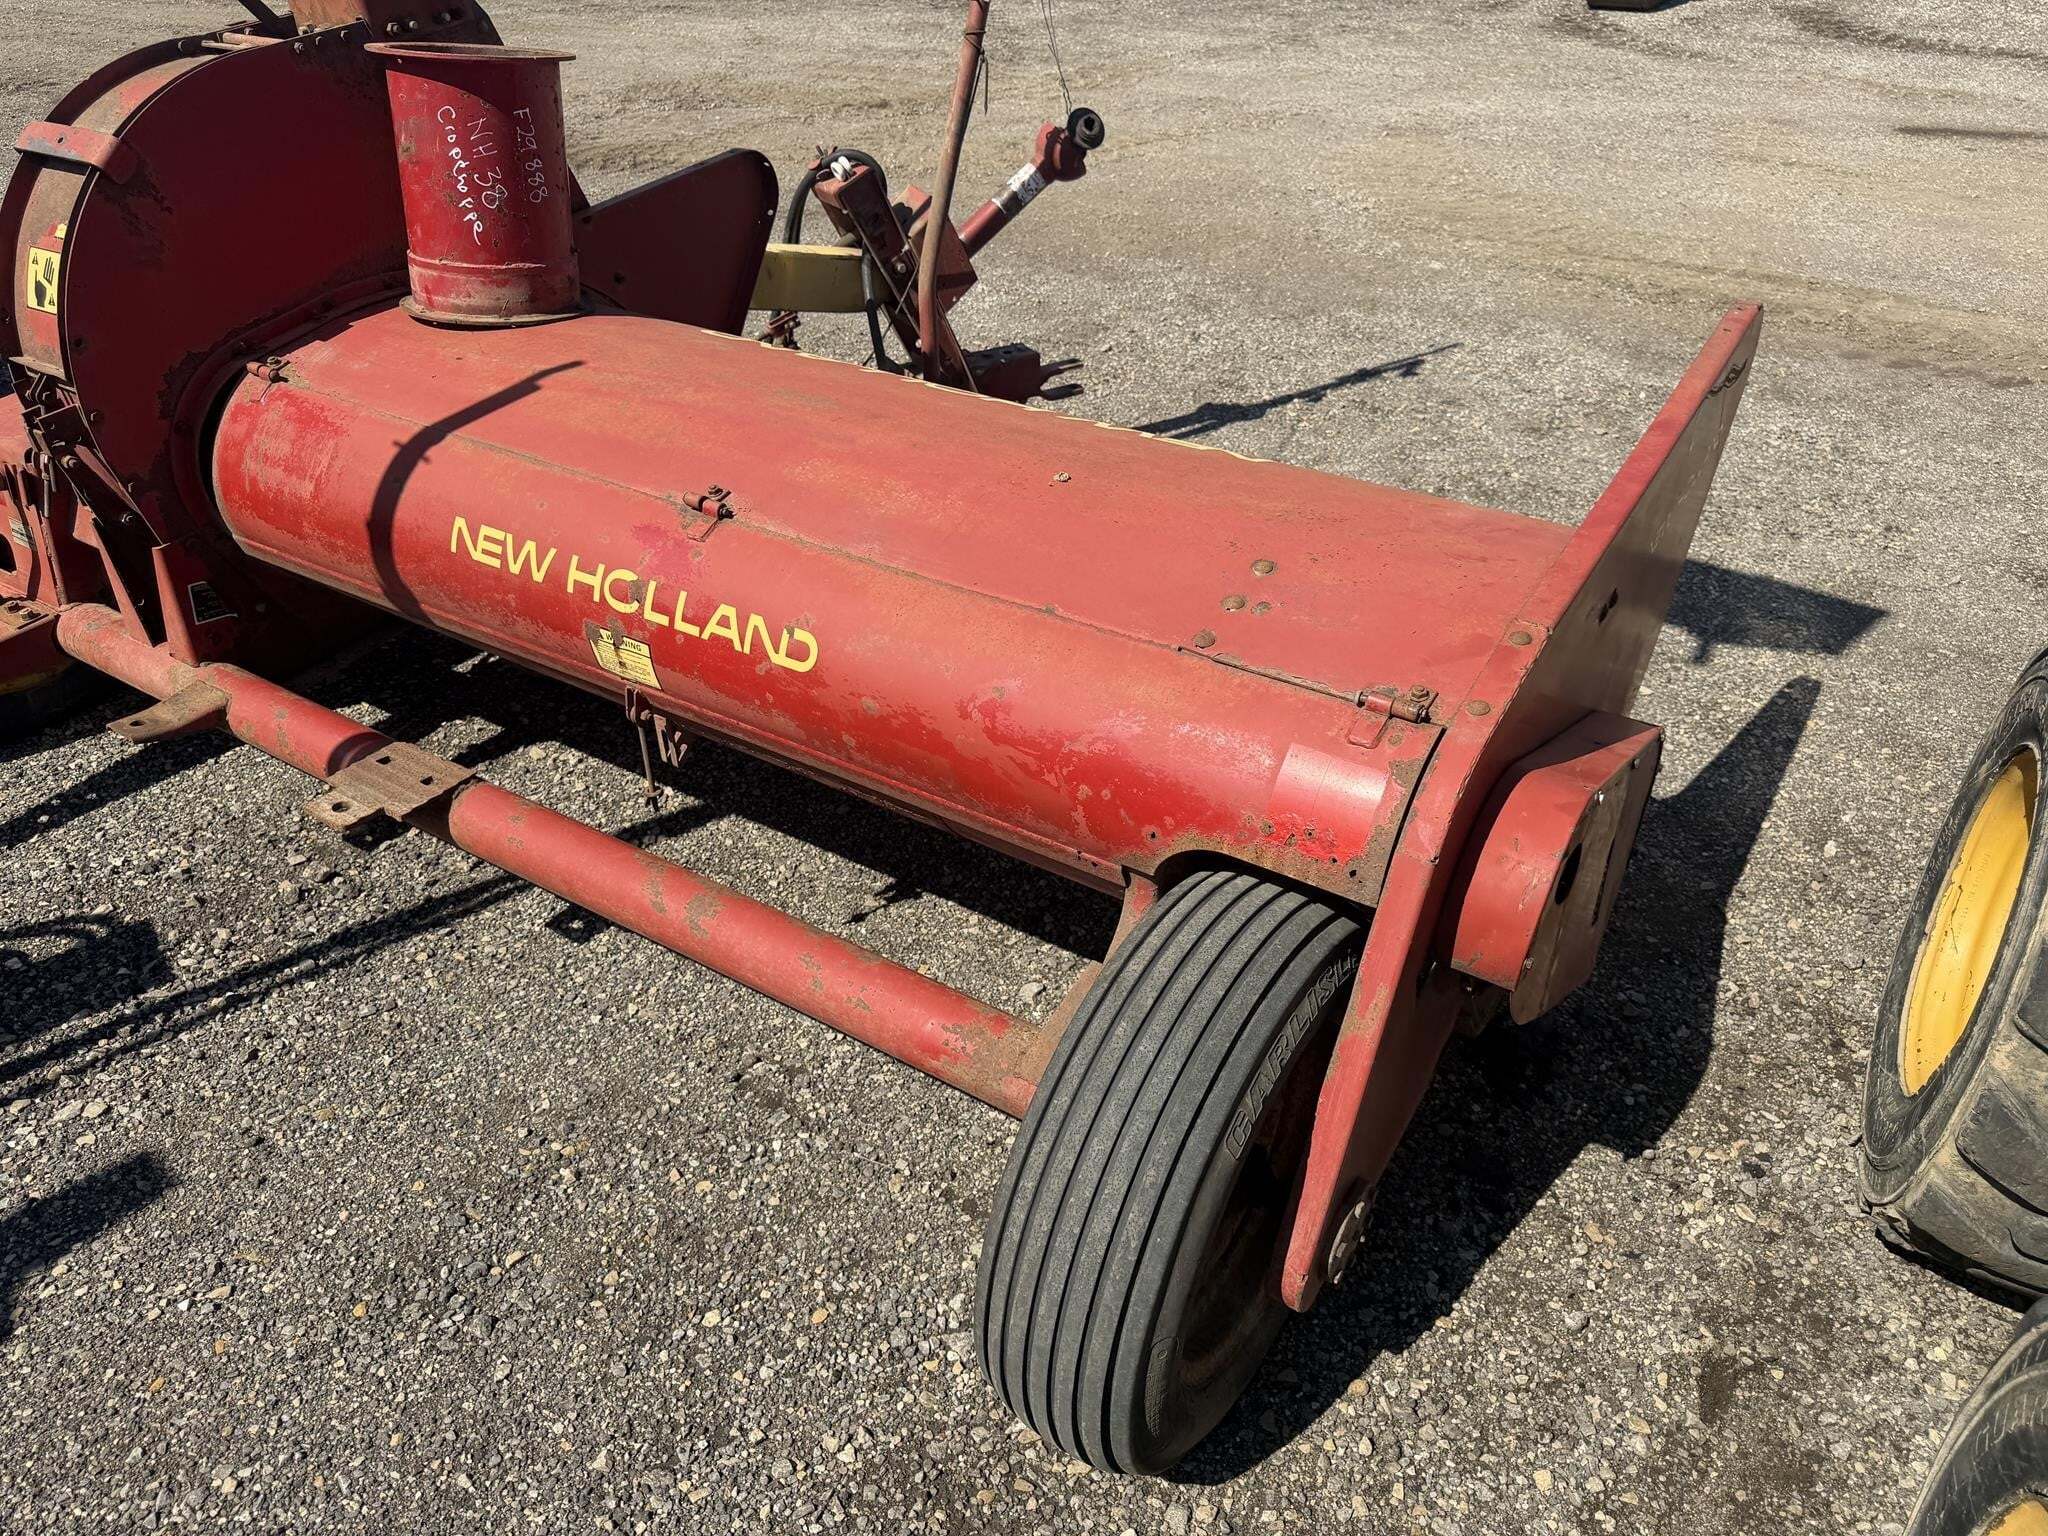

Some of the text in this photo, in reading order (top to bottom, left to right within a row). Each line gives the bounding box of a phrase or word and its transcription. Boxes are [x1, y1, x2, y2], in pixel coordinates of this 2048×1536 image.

[467, 118, 508, 210] NH 38
[450, 516, 557, 583] NEW
[566, 554, 819, 673] HOLLAND
[606, 632, 642, 652] WNING
[1225, 952, 1359, 1160] CARLISL
